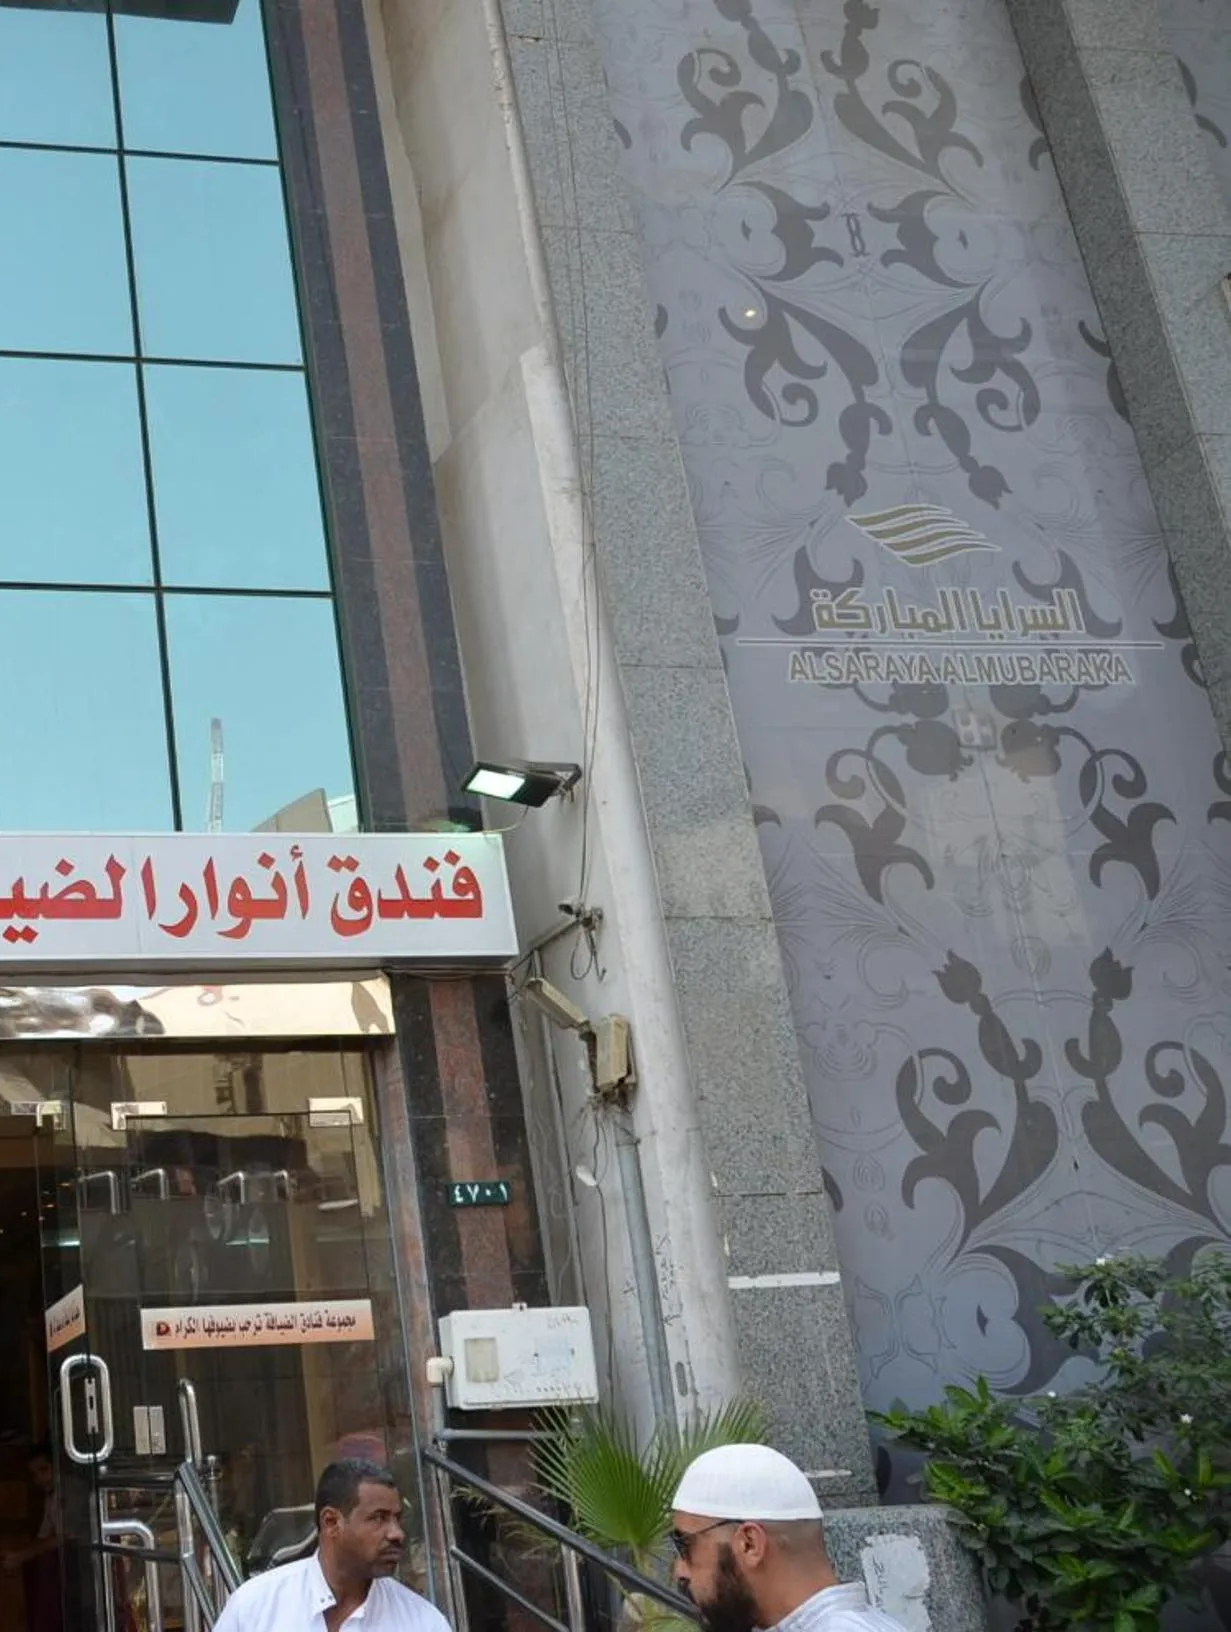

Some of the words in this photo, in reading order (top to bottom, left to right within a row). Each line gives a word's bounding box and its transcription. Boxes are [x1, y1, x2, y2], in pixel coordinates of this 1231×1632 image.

[810, 587, 968, 640] المباركة
[969, 588, 1086, 641] السرايا
[789, 652, 937, 683] ALSARAYA
[940, 653, 1134, 685] ALMUBARAKA
[158, 844, 310, 940] أنوار
[327, 849, 484, 938] فندق
[454, 1183, 508, 1203] ٤٧٠١
